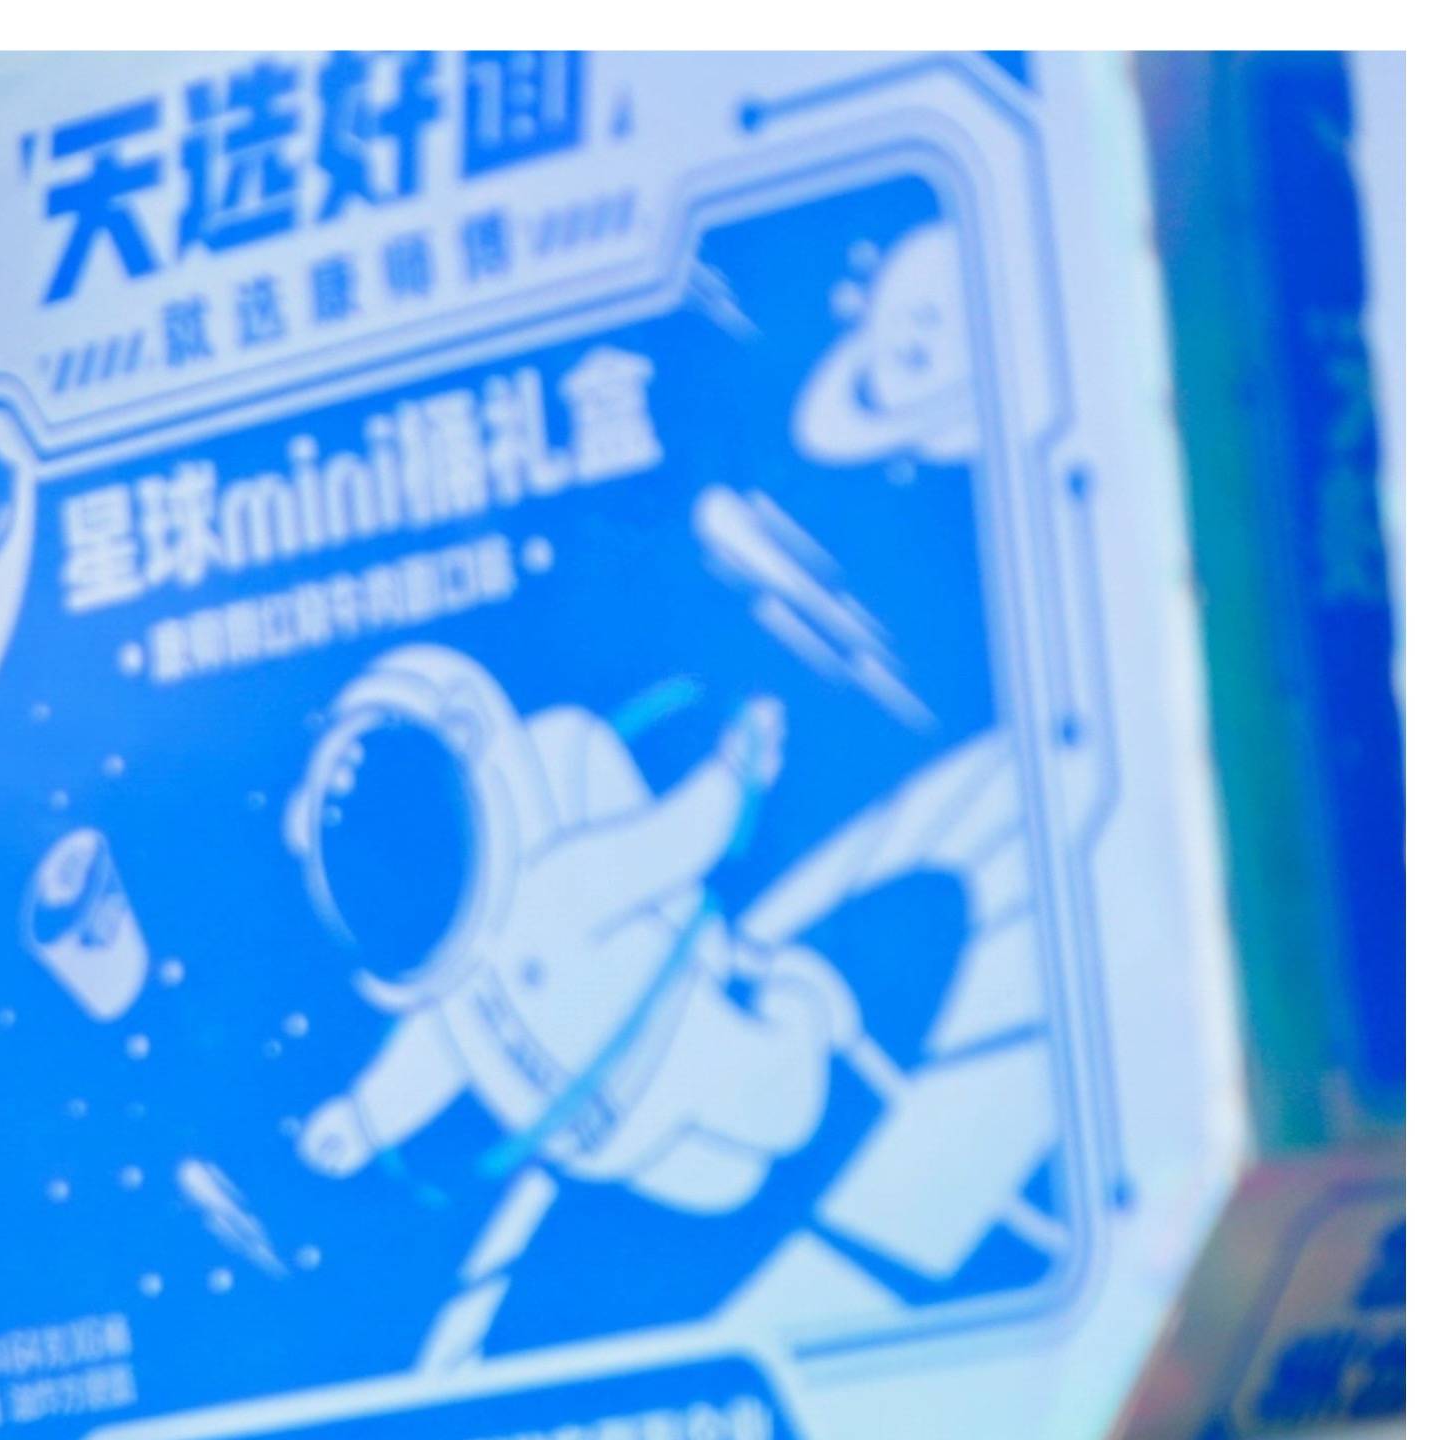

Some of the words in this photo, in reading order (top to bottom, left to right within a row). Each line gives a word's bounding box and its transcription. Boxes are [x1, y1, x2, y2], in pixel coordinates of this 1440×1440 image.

[61, 345, 661, 614] 星球mini桶礼盒
